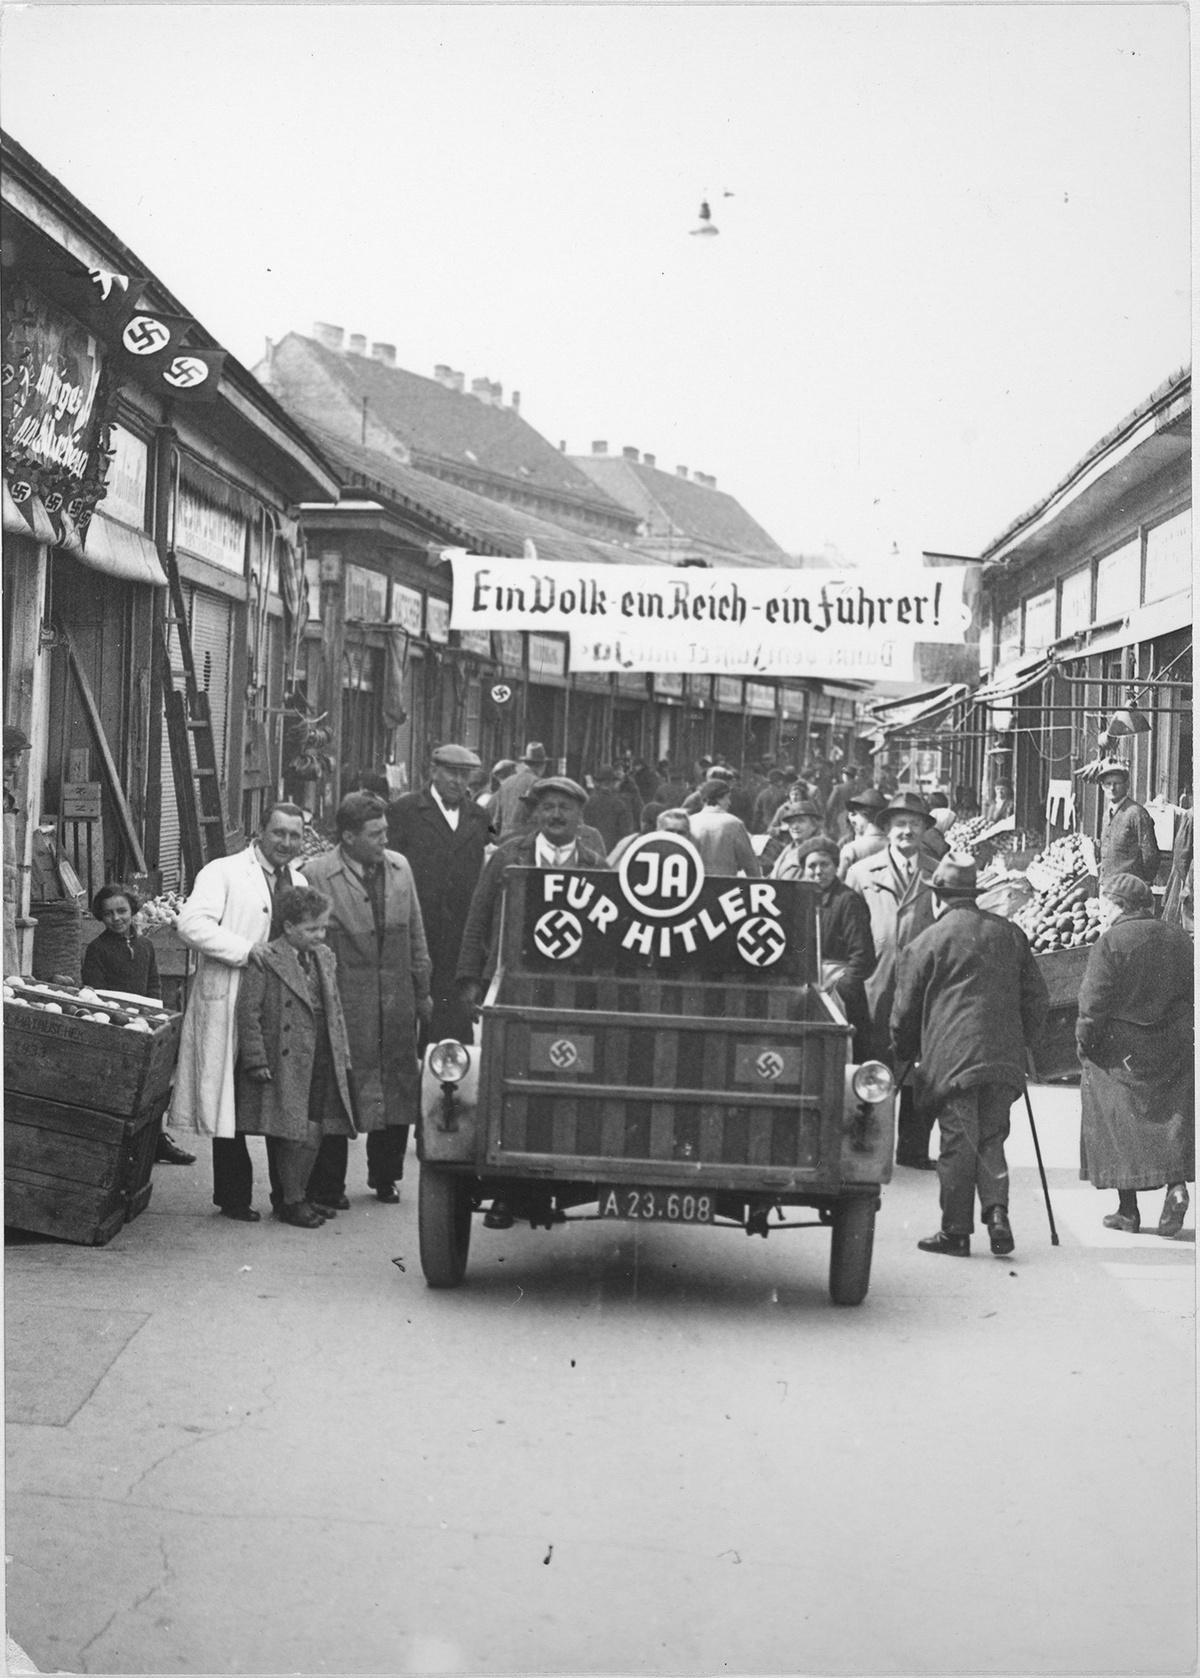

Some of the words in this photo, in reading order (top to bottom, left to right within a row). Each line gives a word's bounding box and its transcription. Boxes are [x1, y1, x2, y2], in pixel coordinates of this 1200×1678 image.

[472, 569, 525, 612] Ein
[529, 574, 607, 616] Volk
[621, 580, 665, 618] ein
[667, 580, 747, 626] Reich
[766, 585, 812, 625] ein
[813, 580, 942, 633] Führer!
[634, 851, 689, 898] JA
[543, 873, 619, 934] FÜR
[621, 883, 782, 958] HITLER
[604, 1190, 619, 1216] A
[627, 1191, 711, 1222] 23.608
